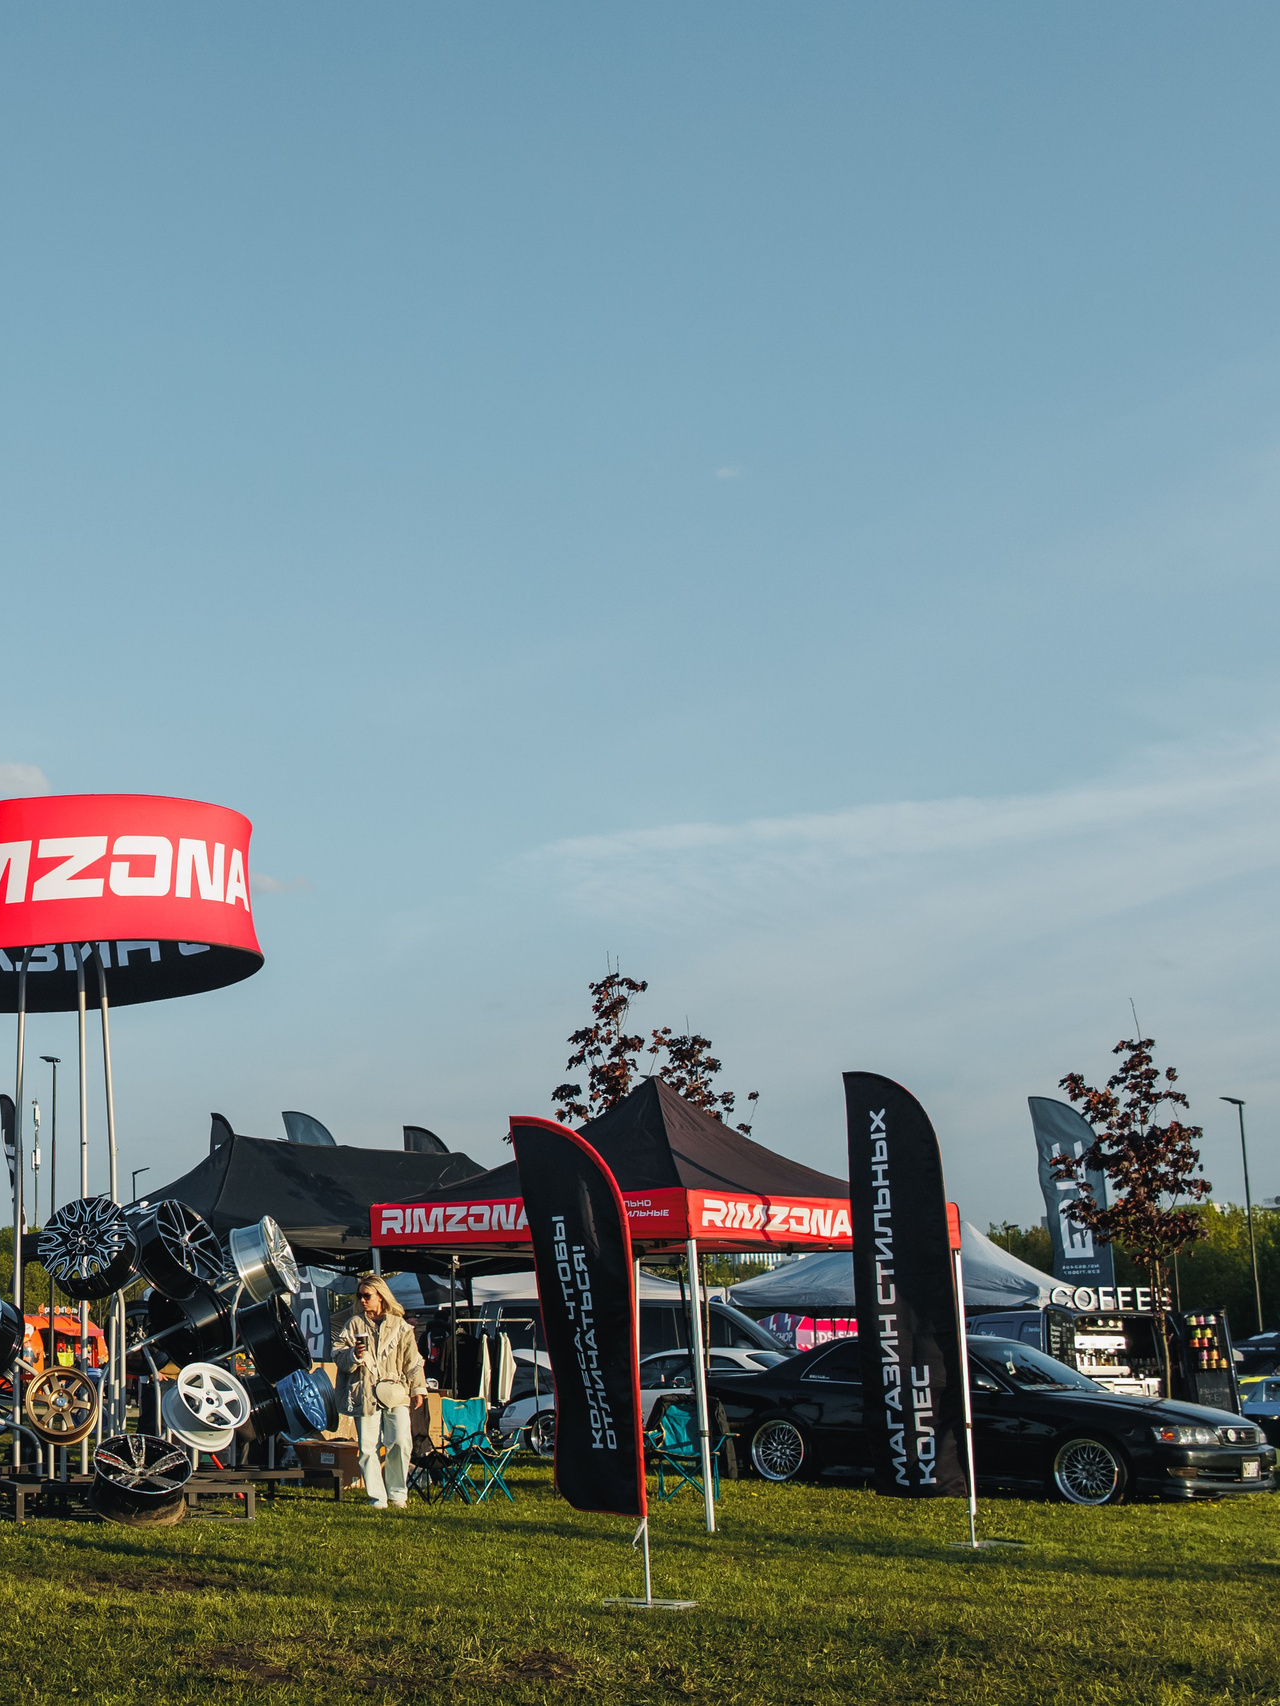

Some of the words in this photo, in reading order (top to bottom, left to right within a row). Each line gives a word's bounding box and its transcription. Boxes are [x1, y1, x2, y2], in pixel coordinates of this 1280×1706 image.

[551, 1215, 575, 1320] ЧТОБЫ
[701, 1198, 853, 1238] RIMZONA
[869, 1108, 896, 1306] СТИЛЬНЫХ
[572, 1245, 617, 1450] ОТЛИЧАТЬСЯ!
[1050, 1286, 1172, 1311] COFFEE
[574, 1327, 604, 1449] КОЛЕСА,
[878, 1313, 910, 1486] МАГАЗИН
[911, 1364, 937, 1485] КОЛЕС
